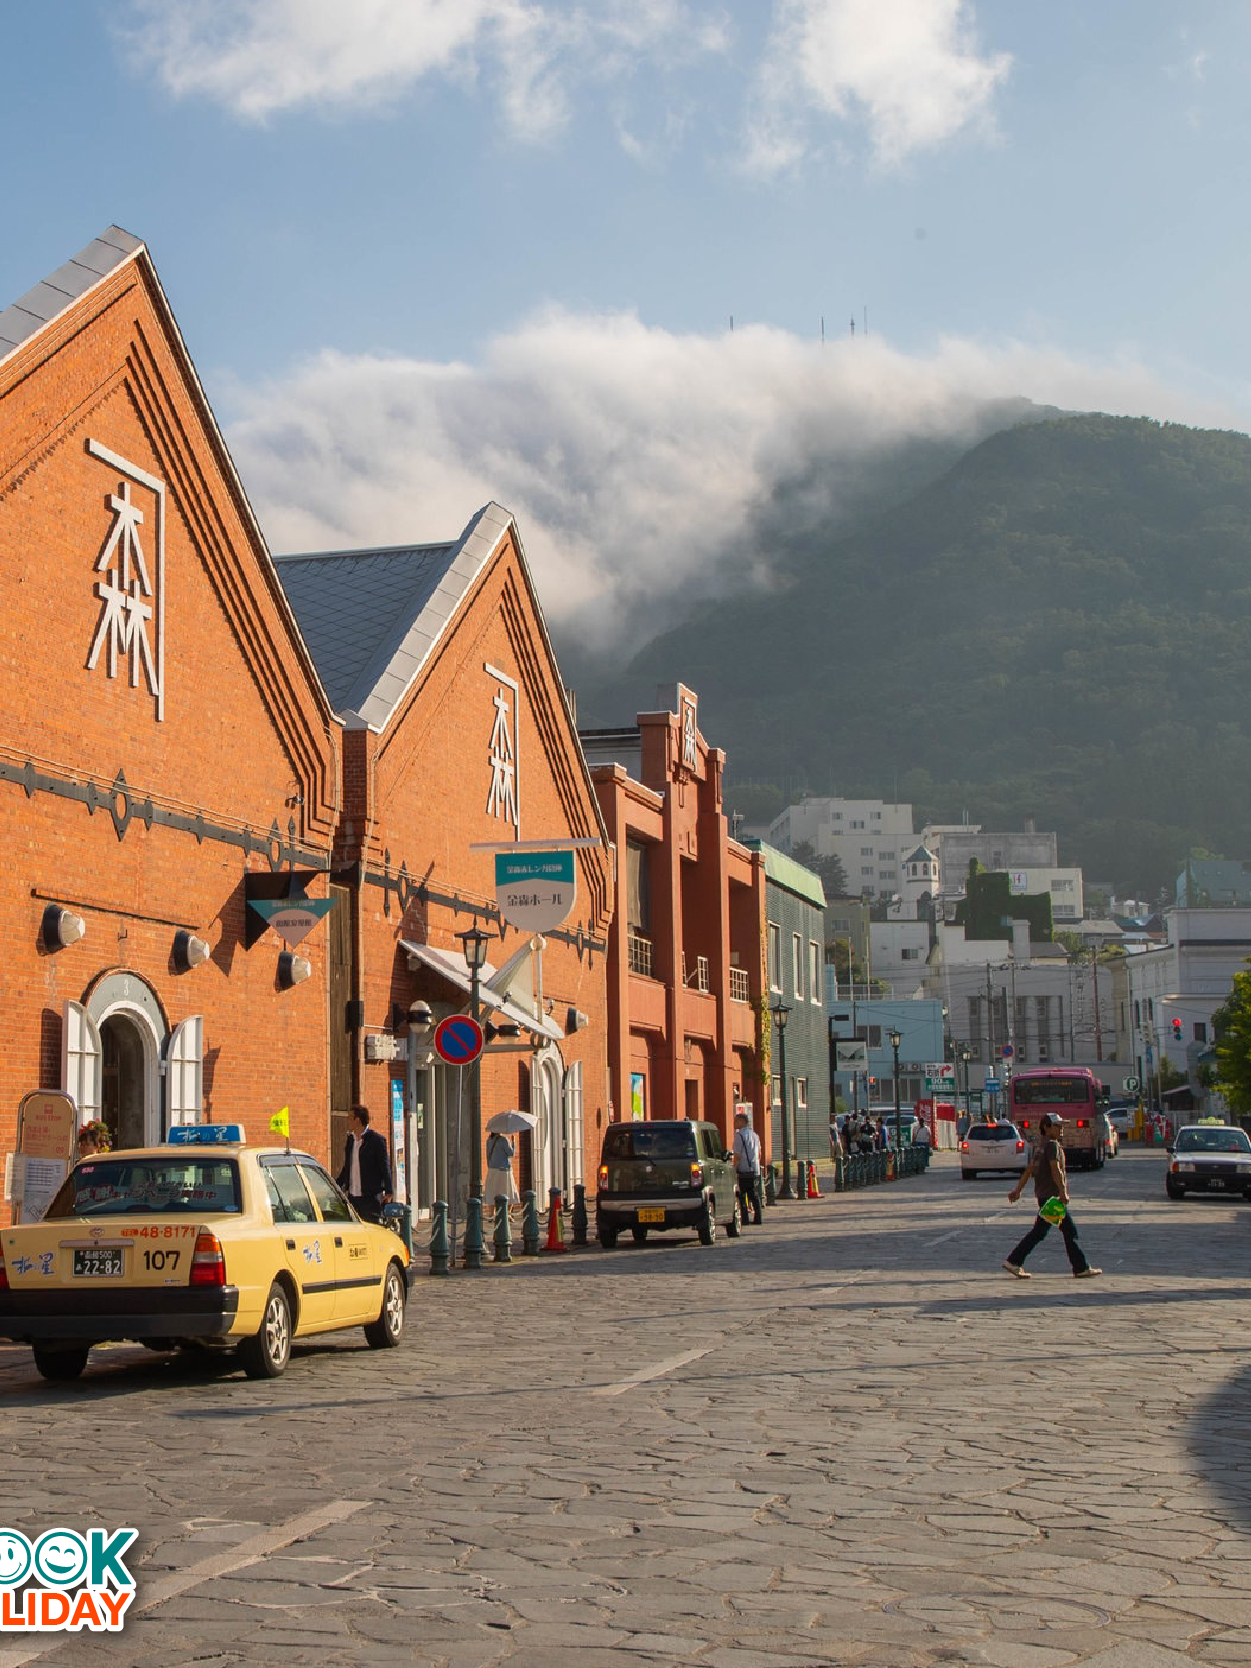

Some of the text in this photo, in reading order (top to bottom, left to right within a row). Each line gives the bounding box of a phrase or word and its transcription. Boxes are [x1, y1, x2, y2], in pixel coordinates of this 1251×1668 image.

[123, 979, 129, 996] 3
[1129, 1080, 1137, 1091] P
[84, 1260, 121, 1274] 22-82
[143, 1250, 181, 1270] 107
